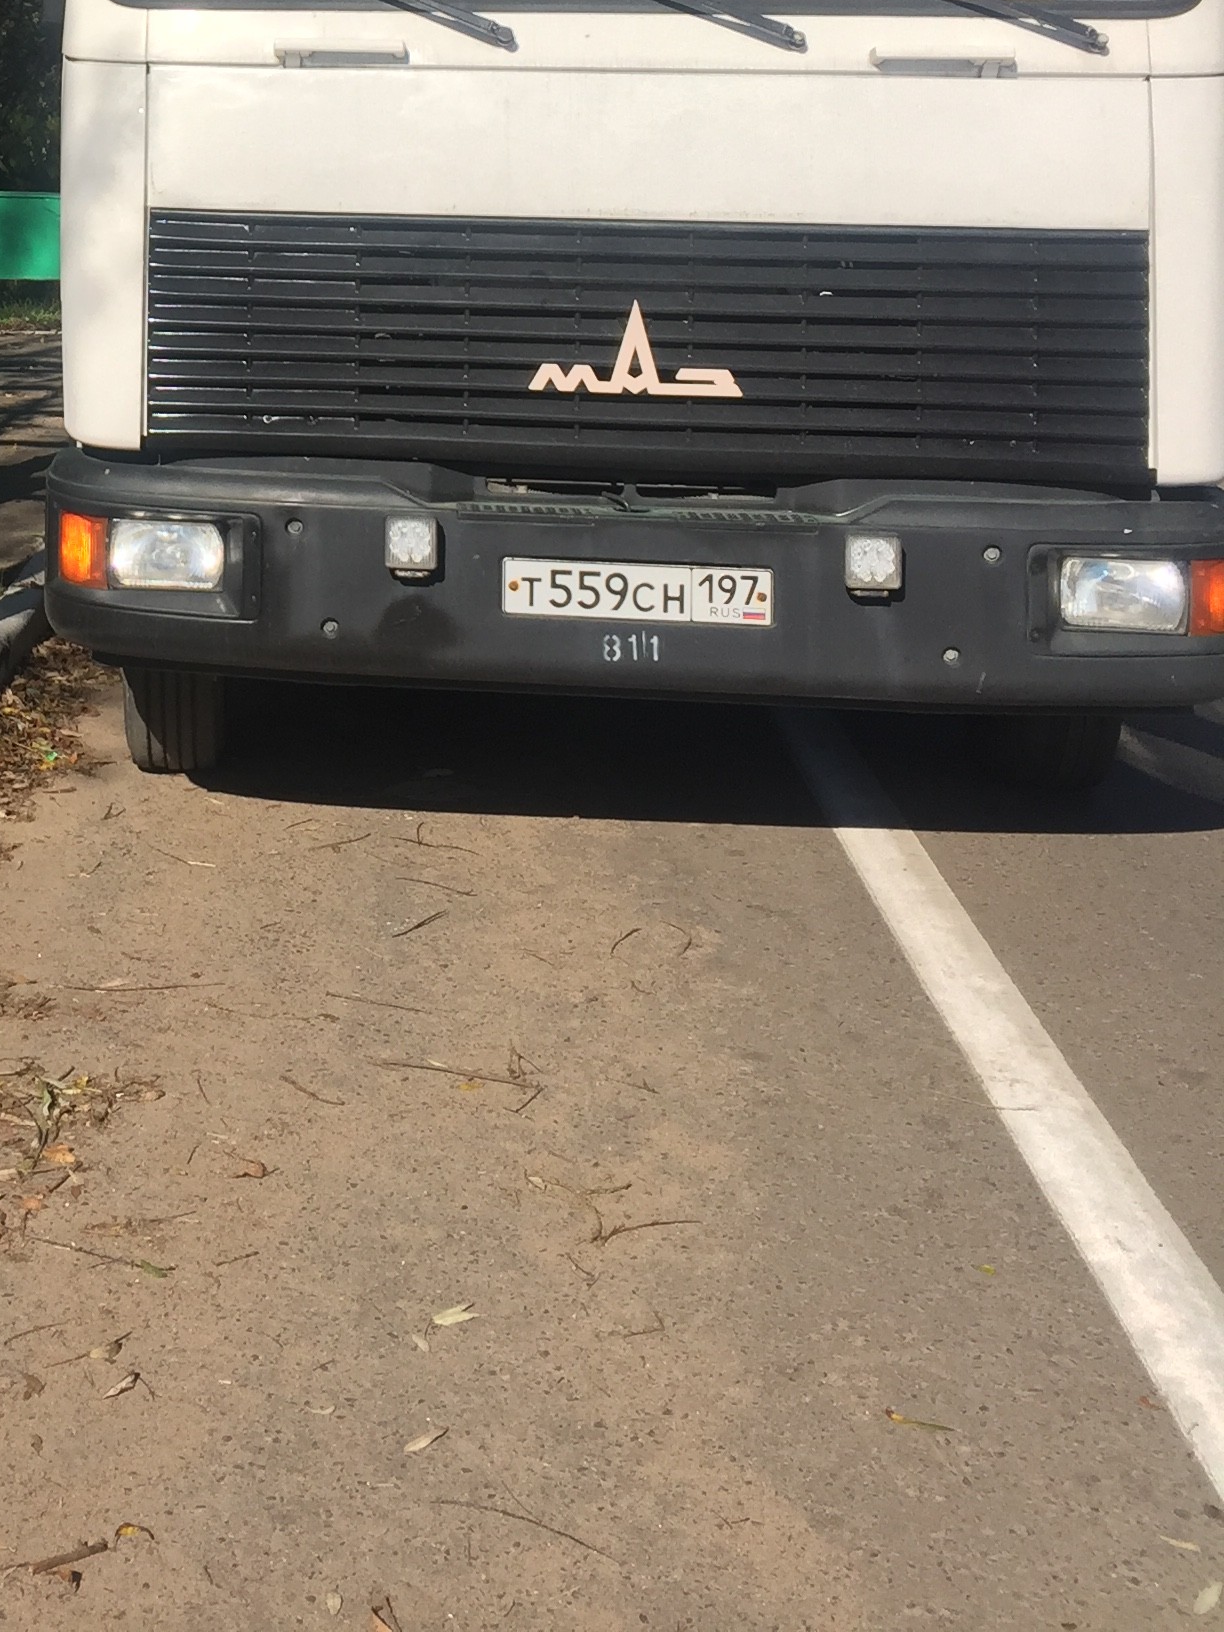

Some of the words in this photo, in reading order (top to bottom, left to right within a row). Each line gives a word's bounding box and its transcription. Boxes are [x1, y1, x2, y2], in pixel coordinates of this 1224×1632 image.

[528, 299, 744, 397] МАЗ
[698, 573, 759, 606] 197
[709, 606, 741, 619] RUS
